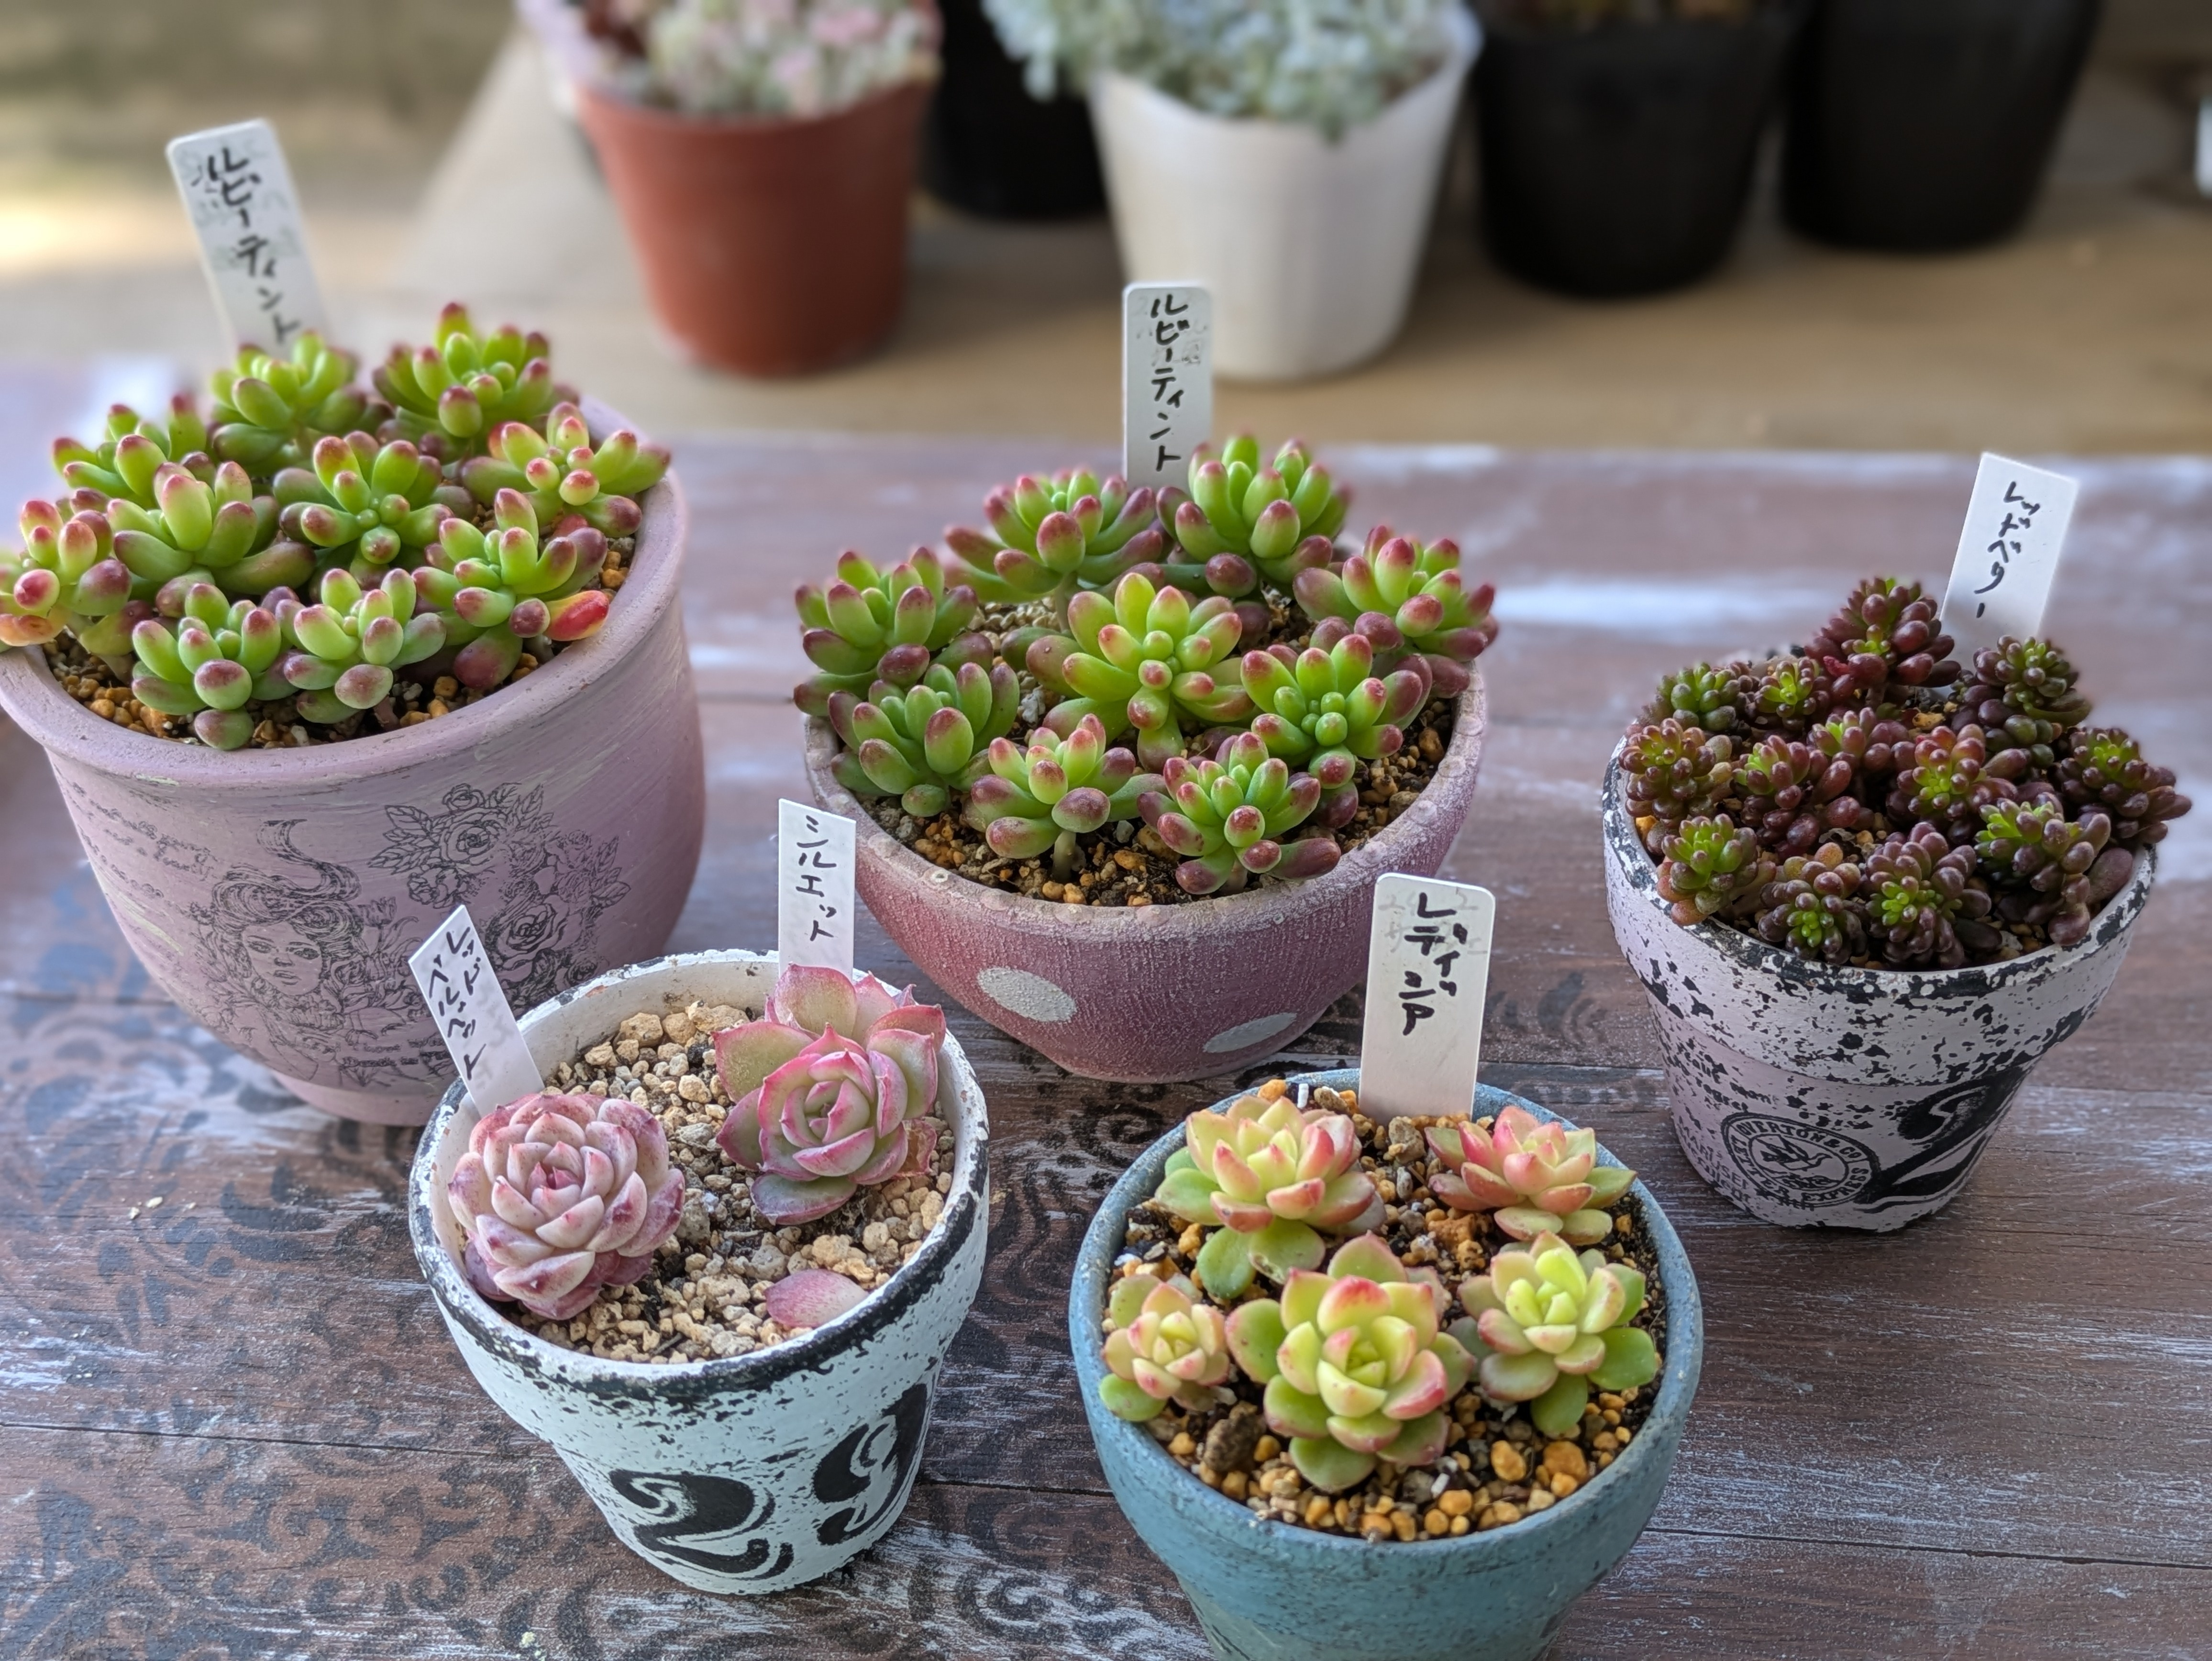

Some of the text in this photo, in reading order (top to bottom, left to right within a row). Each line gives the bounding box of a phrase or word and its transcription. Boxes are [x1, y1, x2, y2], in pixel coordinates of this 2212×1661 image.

[208, 146, 301, 344] ルビーティント
[1150, 294, 1190, 472] ルビーティント
[796, 815, 837, 941] シルエット
[1736, 1120, 1825, 1143] OVERTON
[1839, 1146, 1862, 1159] CO
[1801, 1167, 1869, 1202] EXPRESS
